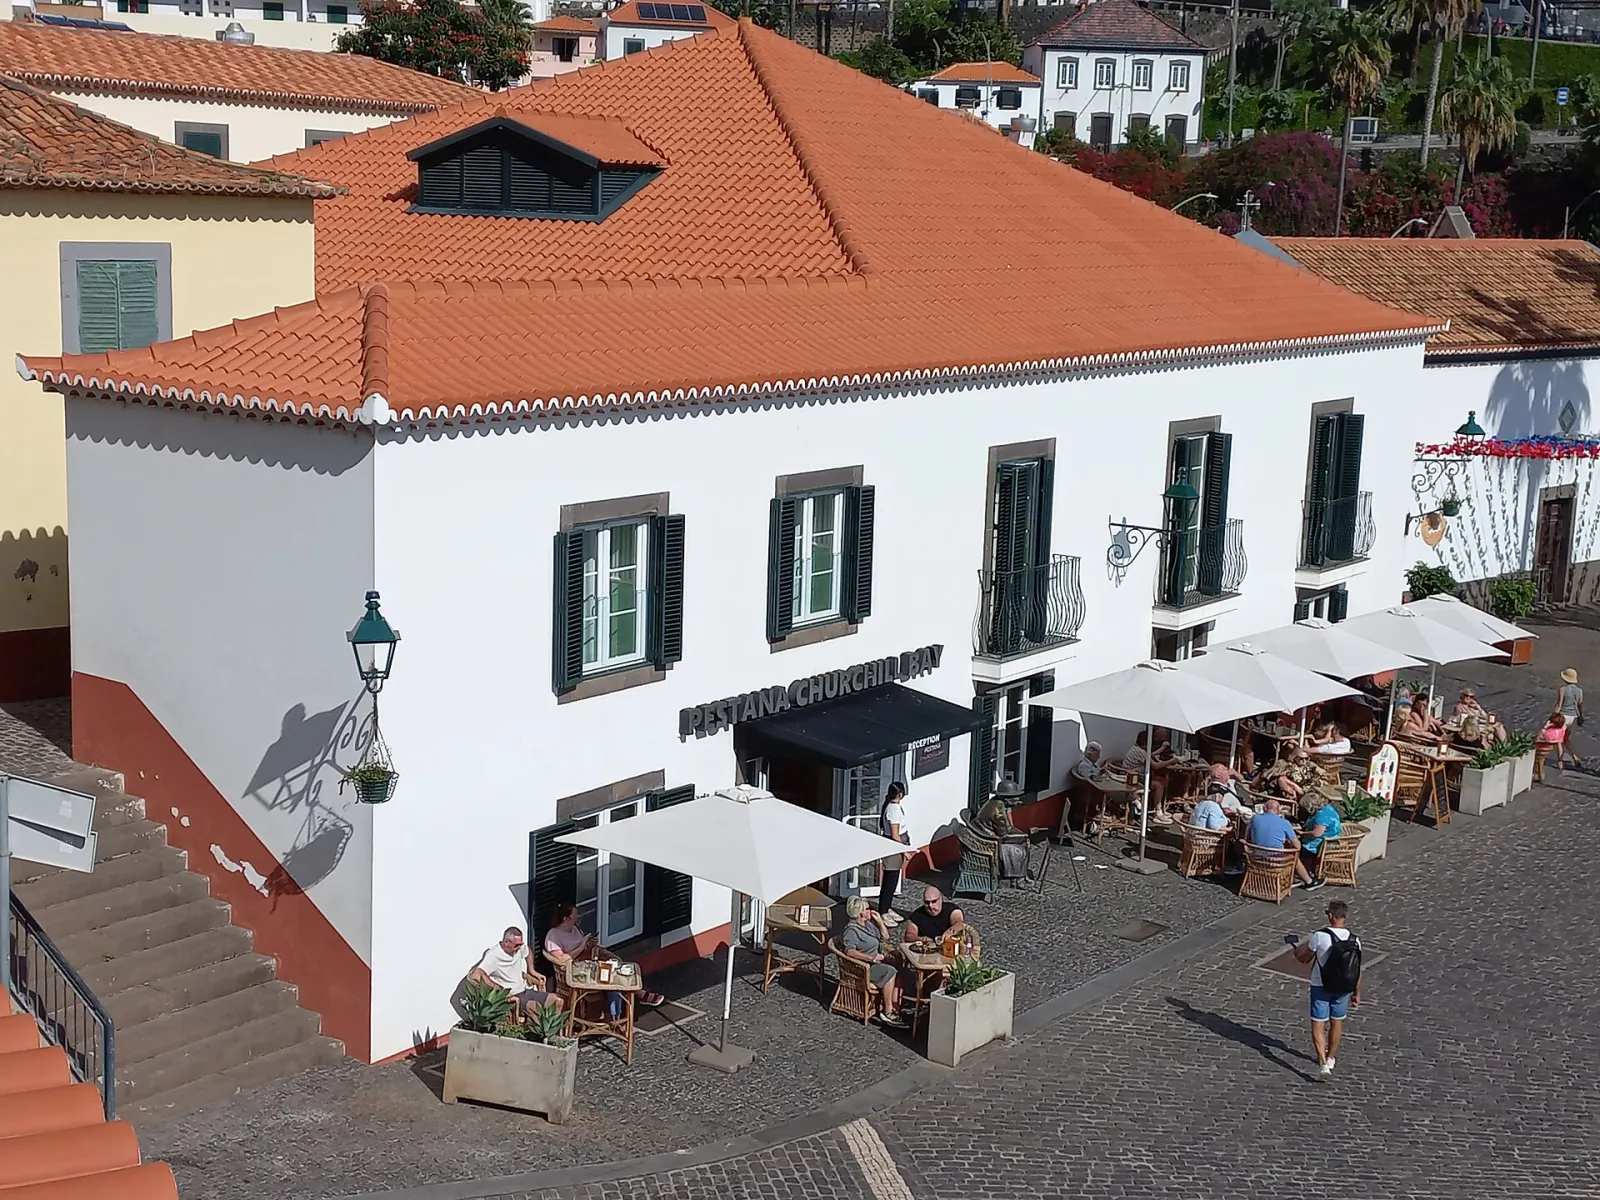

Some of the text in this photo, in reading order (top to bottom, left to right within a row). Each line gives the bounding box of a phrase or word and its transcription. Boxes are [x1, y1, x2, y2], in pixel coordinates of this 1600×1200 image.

[680, 644, 944, 736] PESTANA CHURCHILL BAY
[907, 733, 941, 751] RECEPTION
